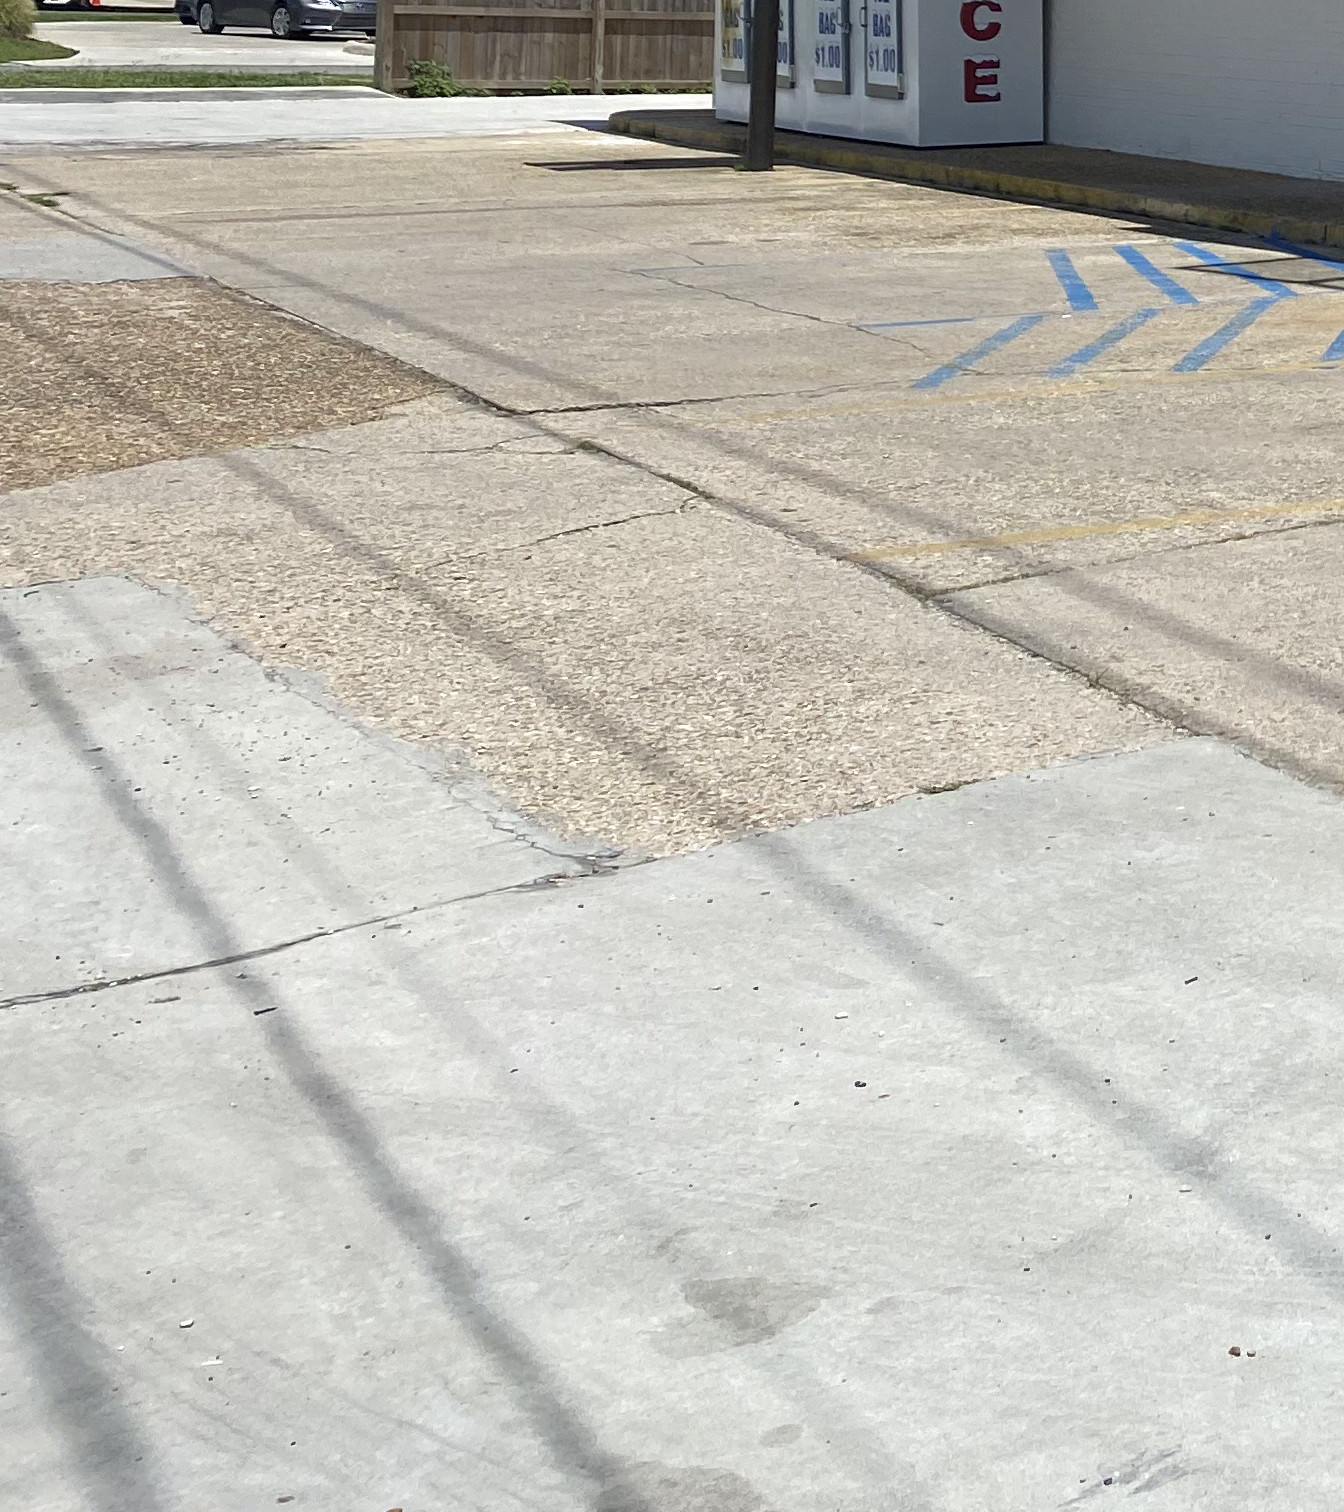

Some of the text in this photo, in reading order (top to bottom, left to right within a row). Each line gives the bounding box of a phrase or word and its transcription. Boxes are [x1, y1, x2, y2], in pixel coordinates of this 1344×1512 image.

[819, 12, 836, 34] BAG
[873, 14, 891, 37] BAG
[815, 45, 840, 68] $1.00
[869, 48, 896, 72] $1.00
